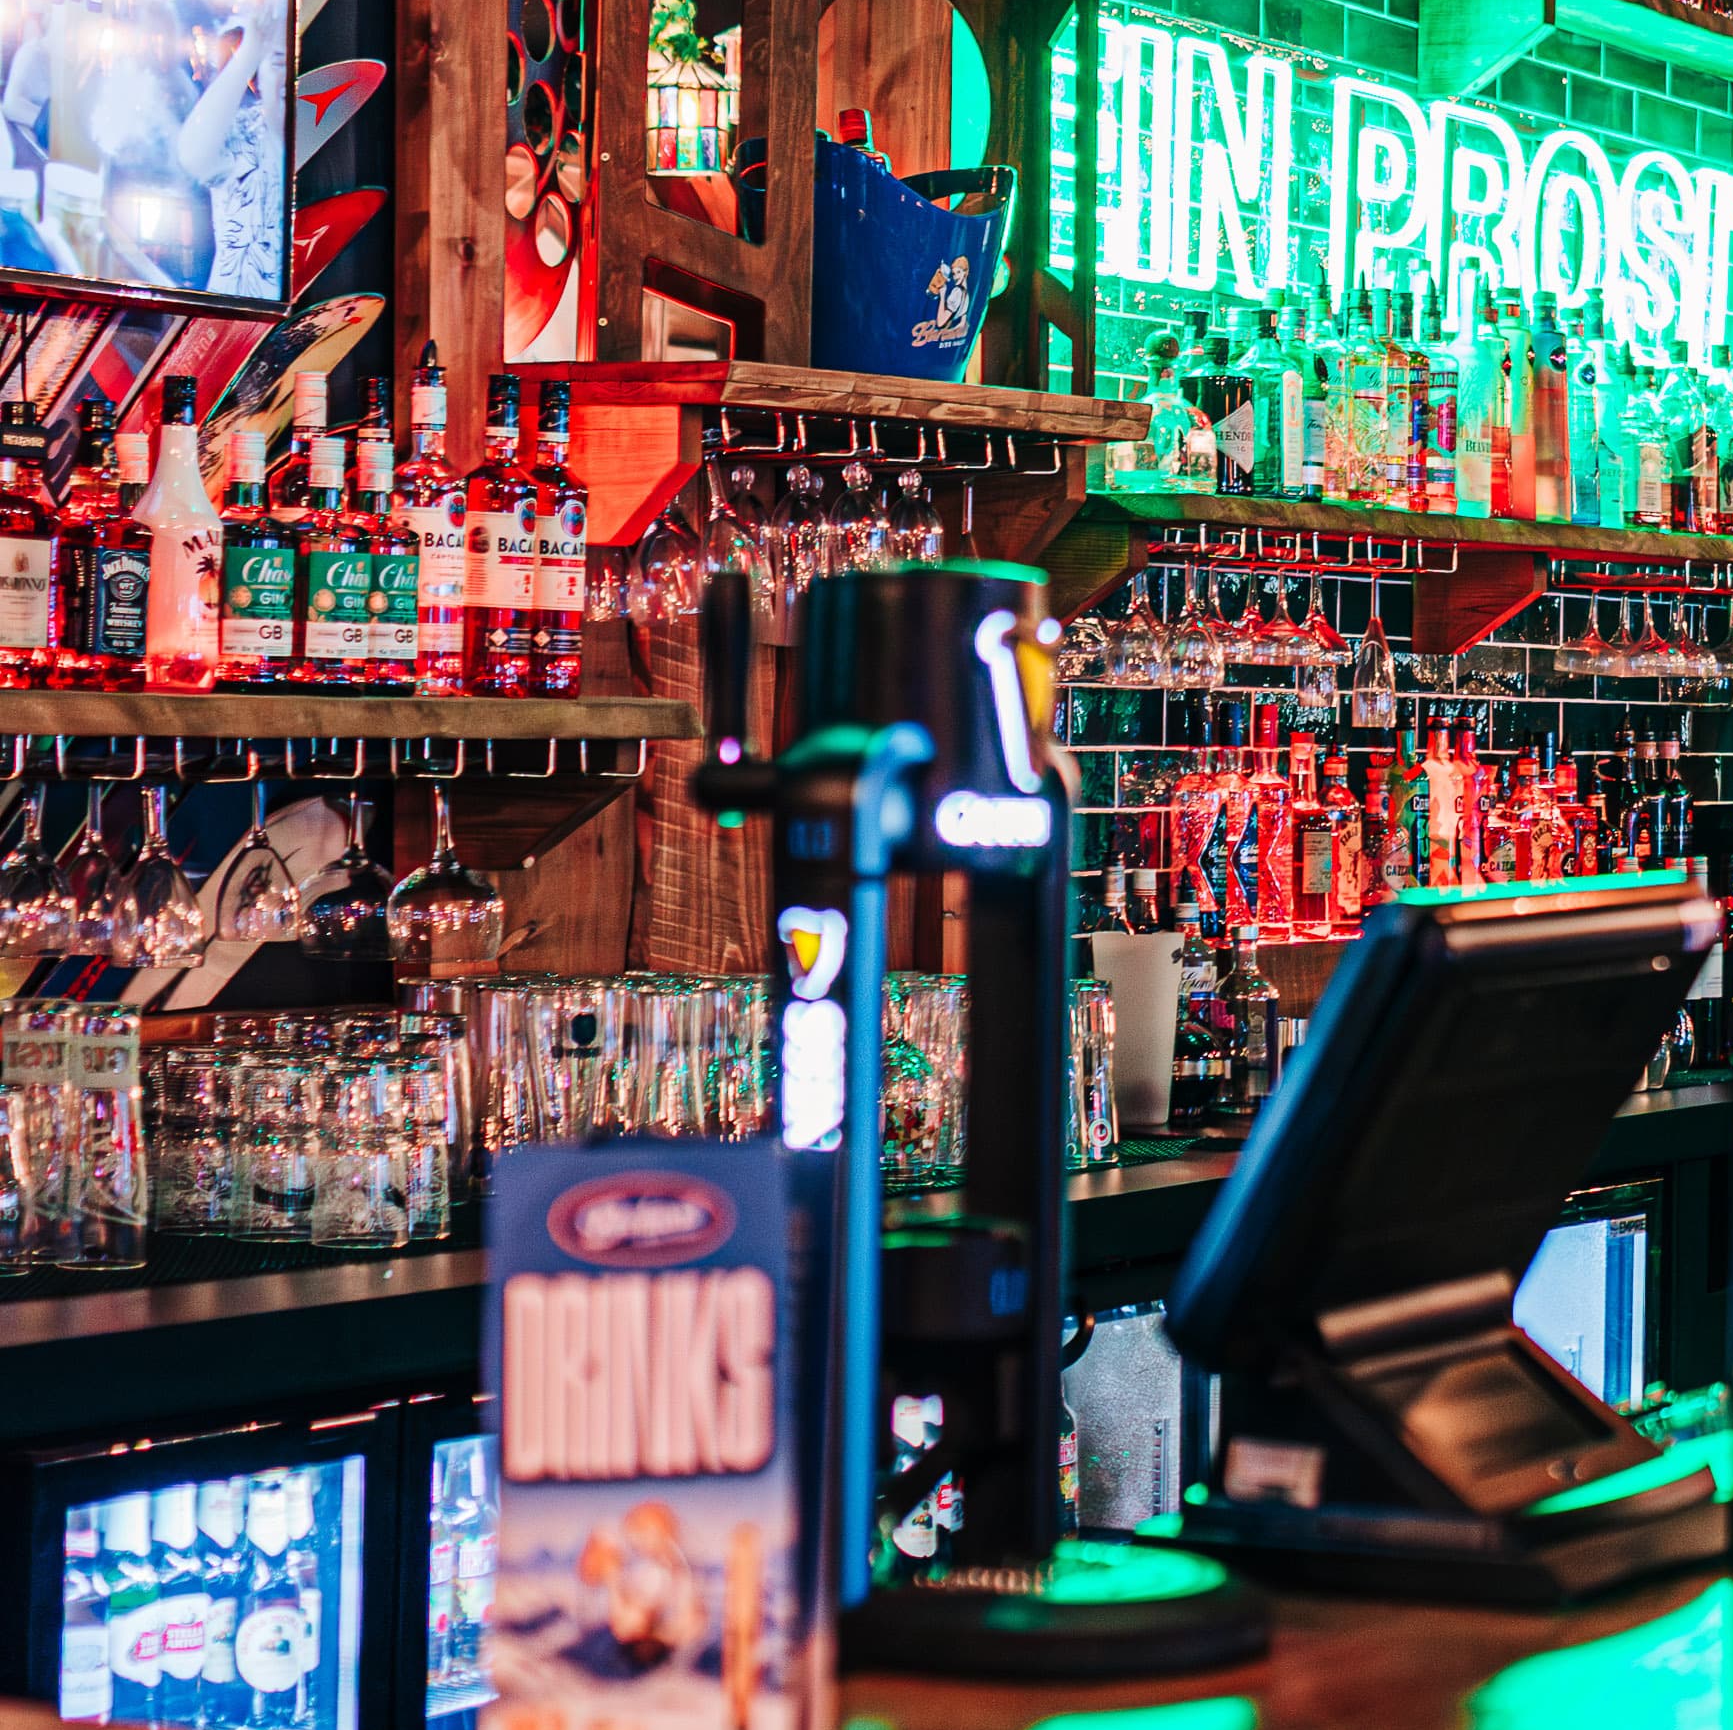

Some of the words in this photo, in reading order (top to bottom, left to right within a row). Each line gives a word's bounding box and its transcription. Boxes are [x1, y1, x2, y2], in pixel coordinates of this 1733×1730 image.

[259, 624, 283, 640] GB
[342, 628, 363, 643] GB
[394, 628, 414, 644] GB
[503, 1266, 777, 1482] DRINKS
